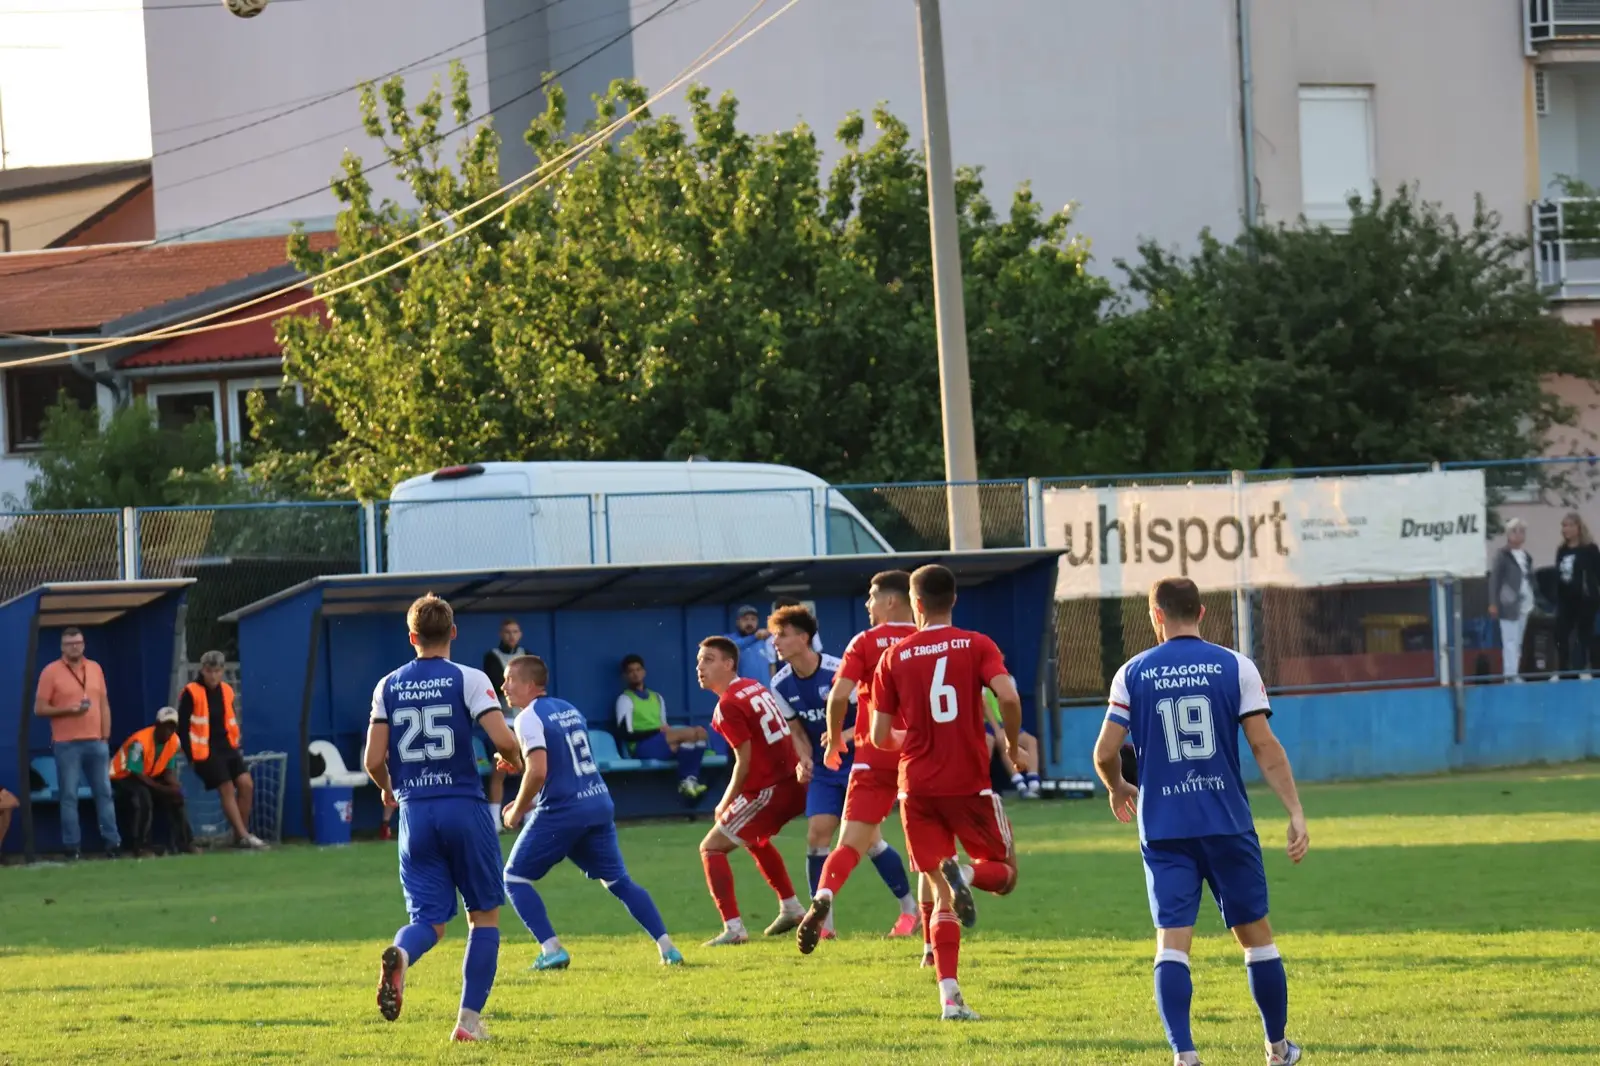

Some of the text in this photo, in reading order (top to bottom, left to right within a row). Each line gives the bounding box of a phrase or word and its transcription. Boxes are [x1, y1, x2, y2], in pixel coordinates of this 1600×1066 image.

[1064, 501, 1289, 576] uhlsport
[900, 639, 971, 661] NK ZAGREB CITY
[1140, 663, 1222, 681] NK ZAGOREC
[390, 678, 453, 693] NK ZAGOREC
[398, 688, 442, 701] KRAPINA
[930, 656, 958, 723] 6
[1154, 676, 1209, 690] KRAPINA
[392, 704, 455, 763] 25
[750, 691, 791, 745] 20
[1155, 694, 1216, 763] 19
[565, 729, 597, 777] 13
